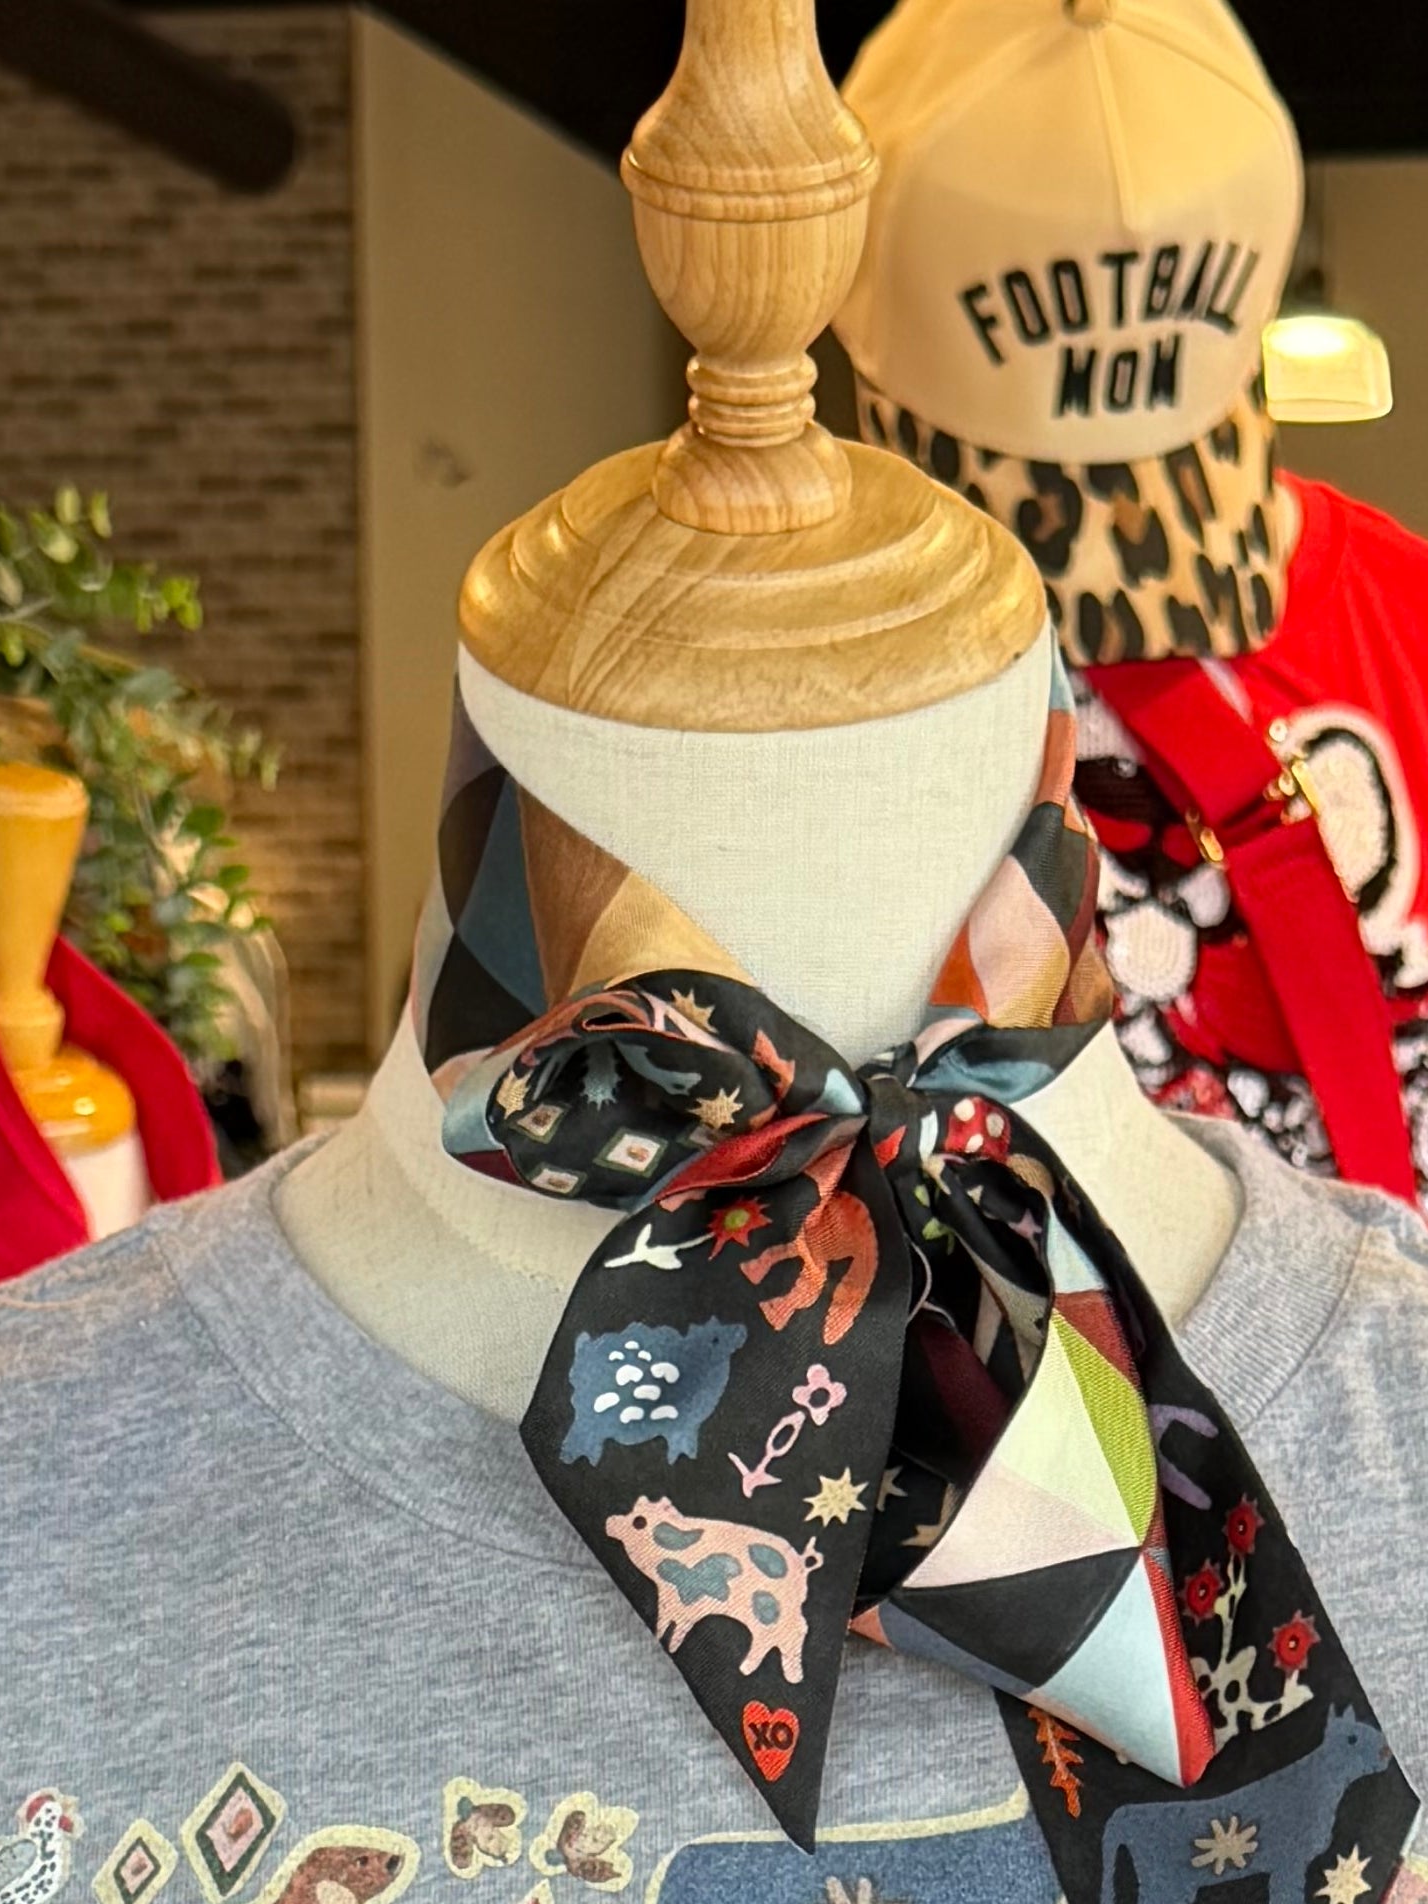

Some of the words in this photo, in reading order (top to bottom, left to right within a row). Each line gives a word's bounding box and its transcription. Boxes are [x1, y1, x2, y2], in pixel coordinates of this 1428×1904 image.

[957, 238, 1260, 367] FOOTBALL
[1051, 334, 1184, 420] MOM
[748, 1720, 795, 1752] XO
